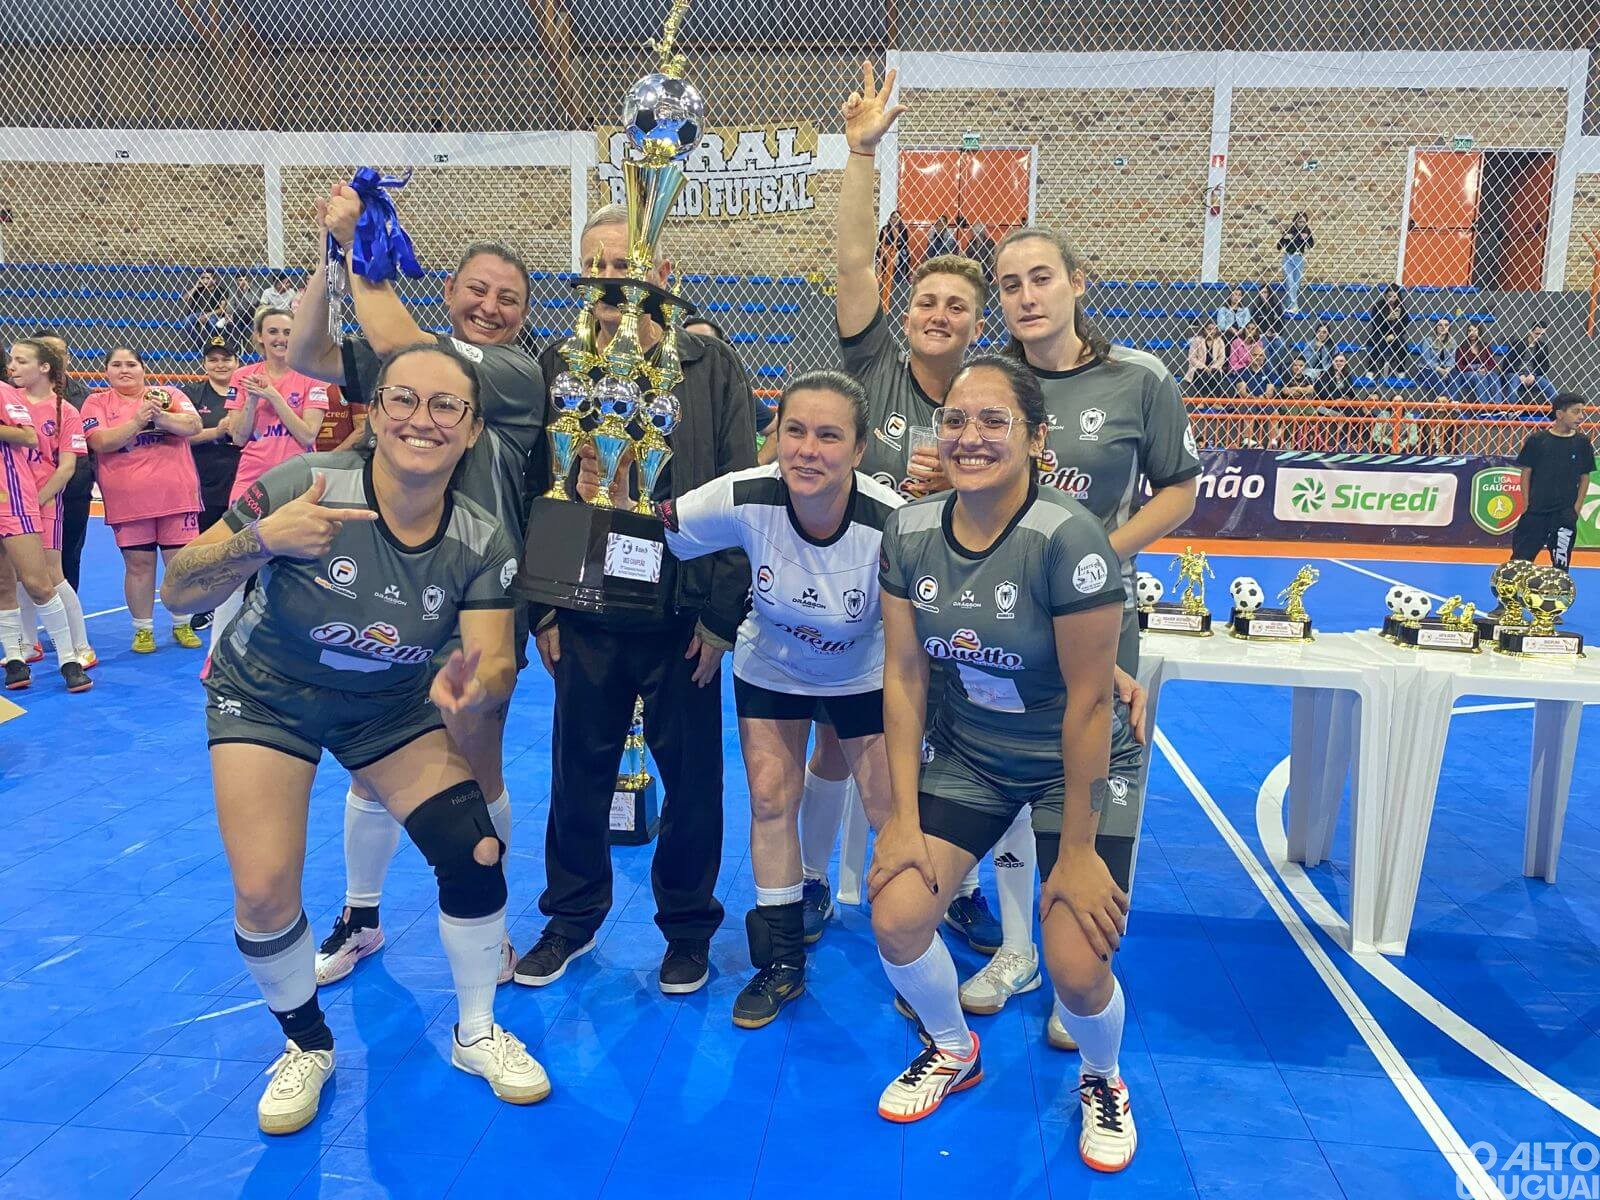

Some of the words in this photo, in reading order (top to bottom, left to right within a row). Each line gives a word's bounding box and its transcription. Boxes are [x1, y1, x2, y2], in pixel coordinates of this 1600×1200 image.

[609, 128, 812, 173] GRAL
[709, 173, 815, 217] FUTSAL
[1039, 467, 1092, 494] etto
[1331, 484, 1440, 512] Sicredi
[1493, 476, 1512, 484] LIGA
[1555, 526, 1574, 567] NIKE
[311, 622, 434, 663] Duetto
[925, 637, 1022, 668] Duetto
